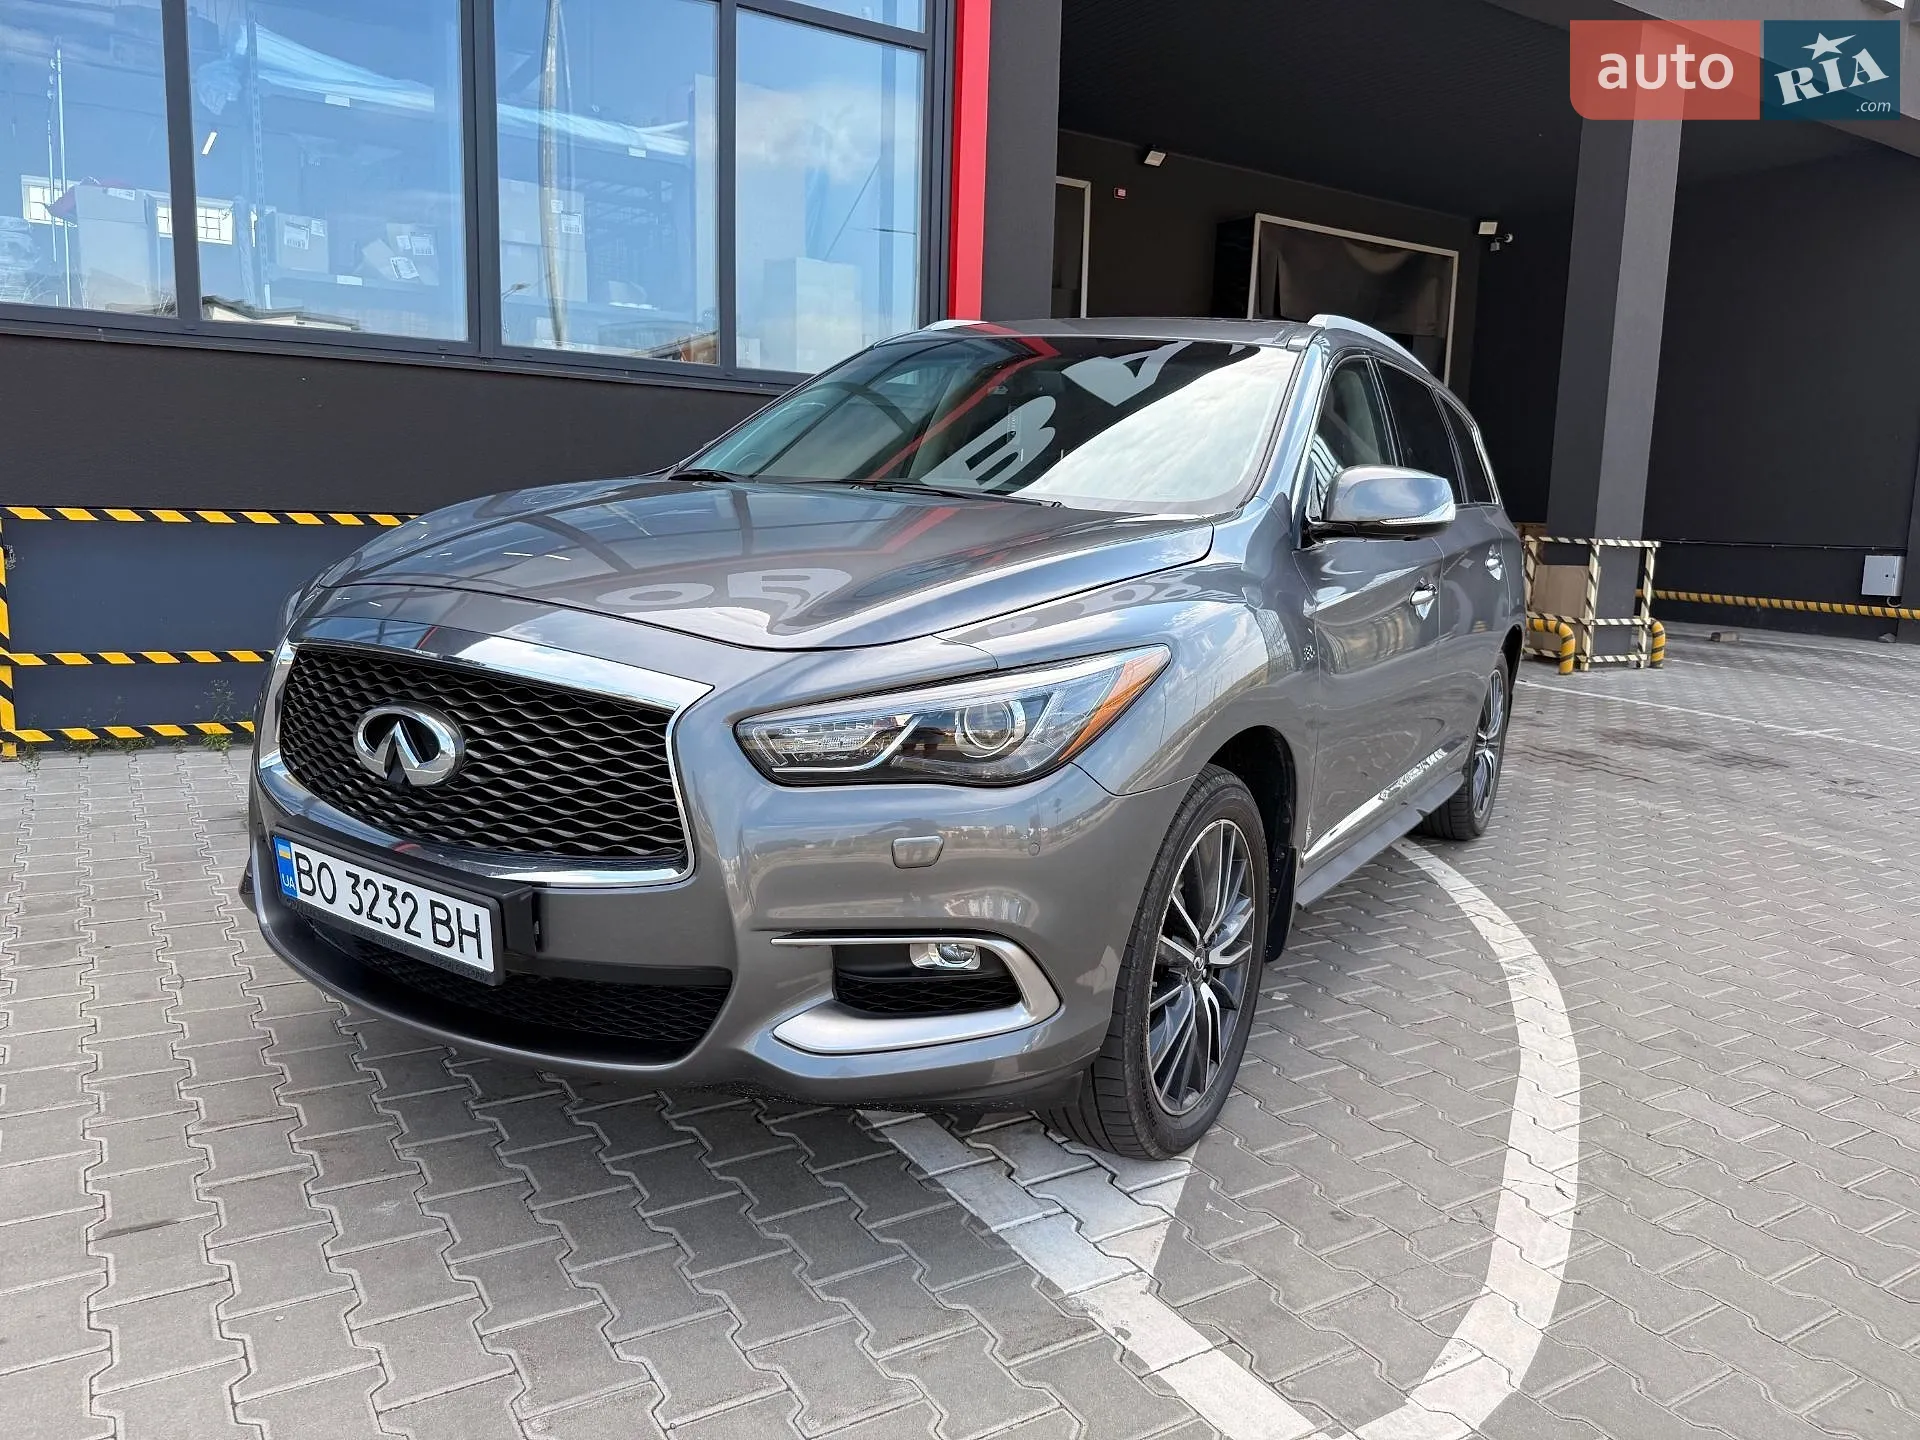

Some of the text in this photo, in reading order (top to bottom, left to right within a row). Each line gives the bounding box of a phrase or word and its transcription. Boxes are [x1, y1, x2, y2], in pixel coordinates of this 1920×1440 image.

[281, 873, 296, 890] UA
[294, 851, 337, 905] BO
[345, 870, 422, 939] 3232
[429, 899, 484, 960] BH
